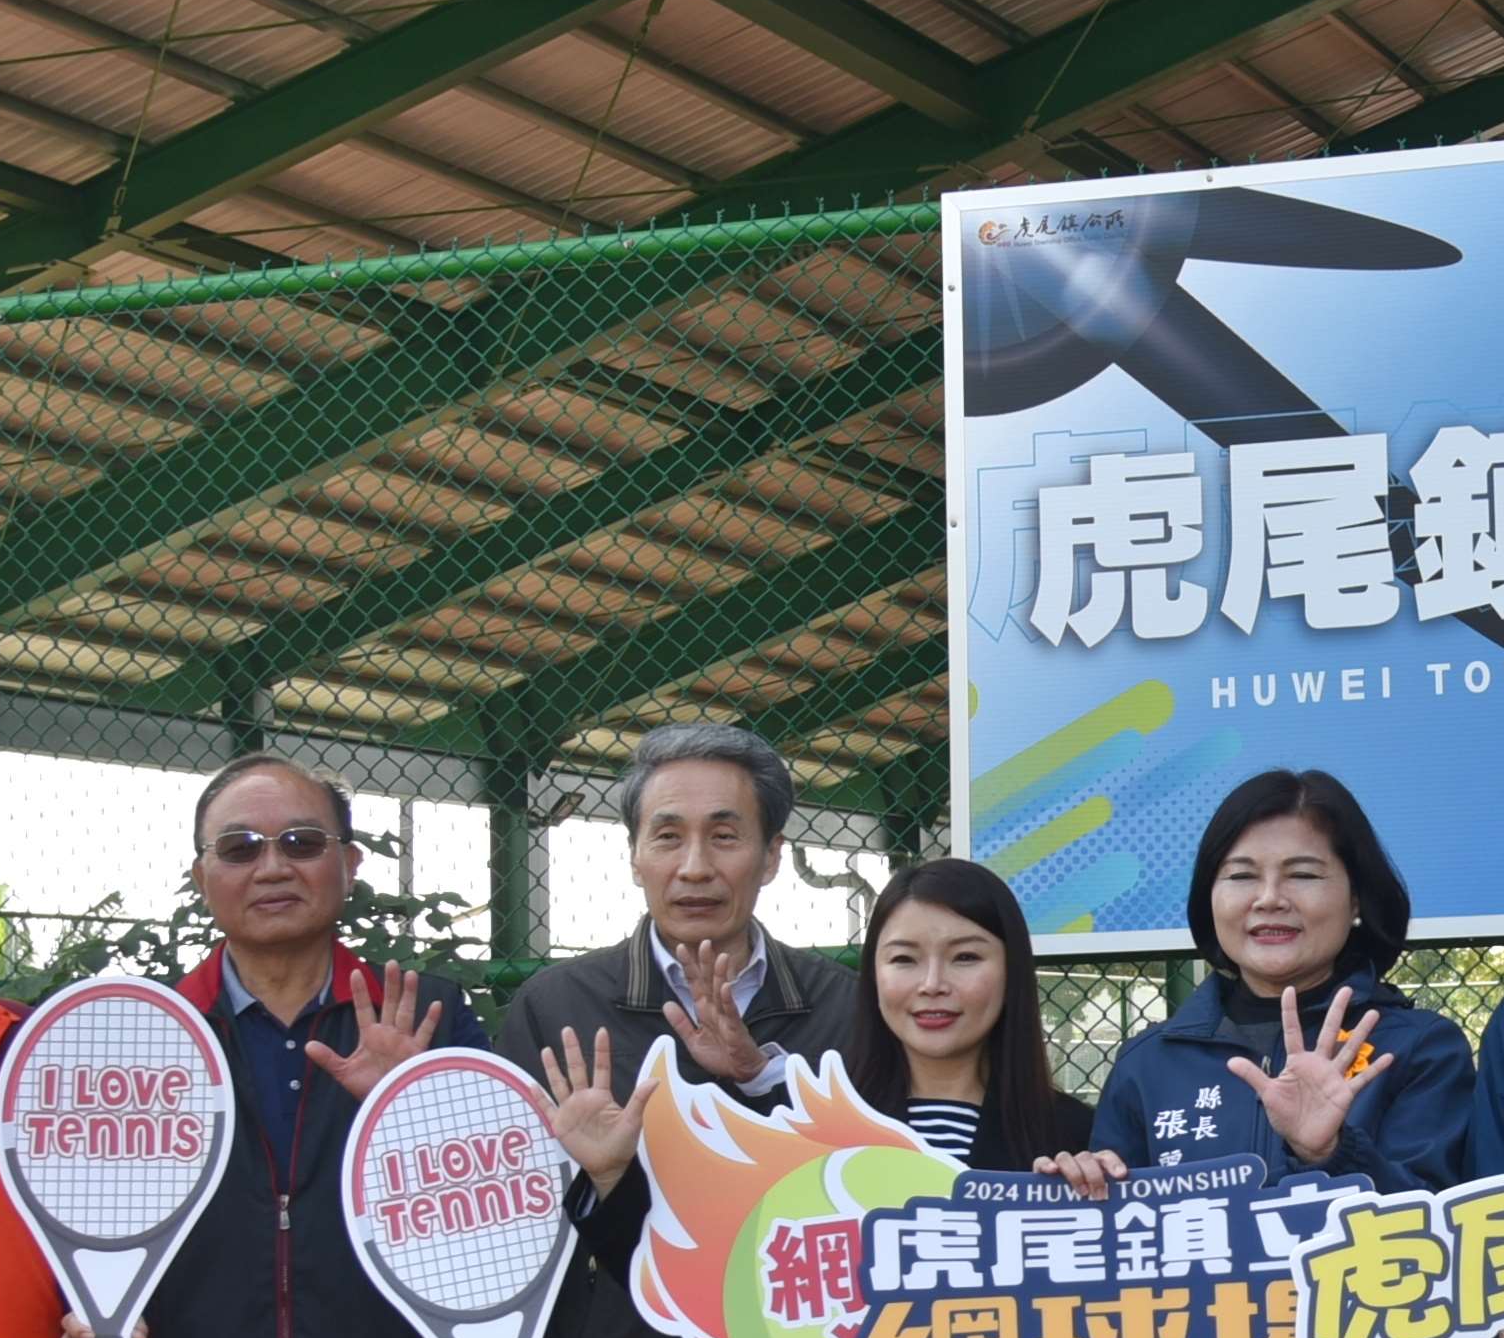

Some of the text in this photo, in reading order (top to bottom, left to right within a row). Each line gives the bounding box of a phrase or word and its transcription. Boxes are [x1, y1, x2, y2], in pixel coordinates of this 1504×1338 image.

[1211, 666, 1391, 709] HUWEI
[41, 1066, 60, 1109] I
[1190, 1084, 1223, 1141] 縣長
[383, 1151, 404, 1195] I
[963, 1181, 1019, 1202] 2024
[1116, 1164, 1253, 1200] TOWNSHIP
